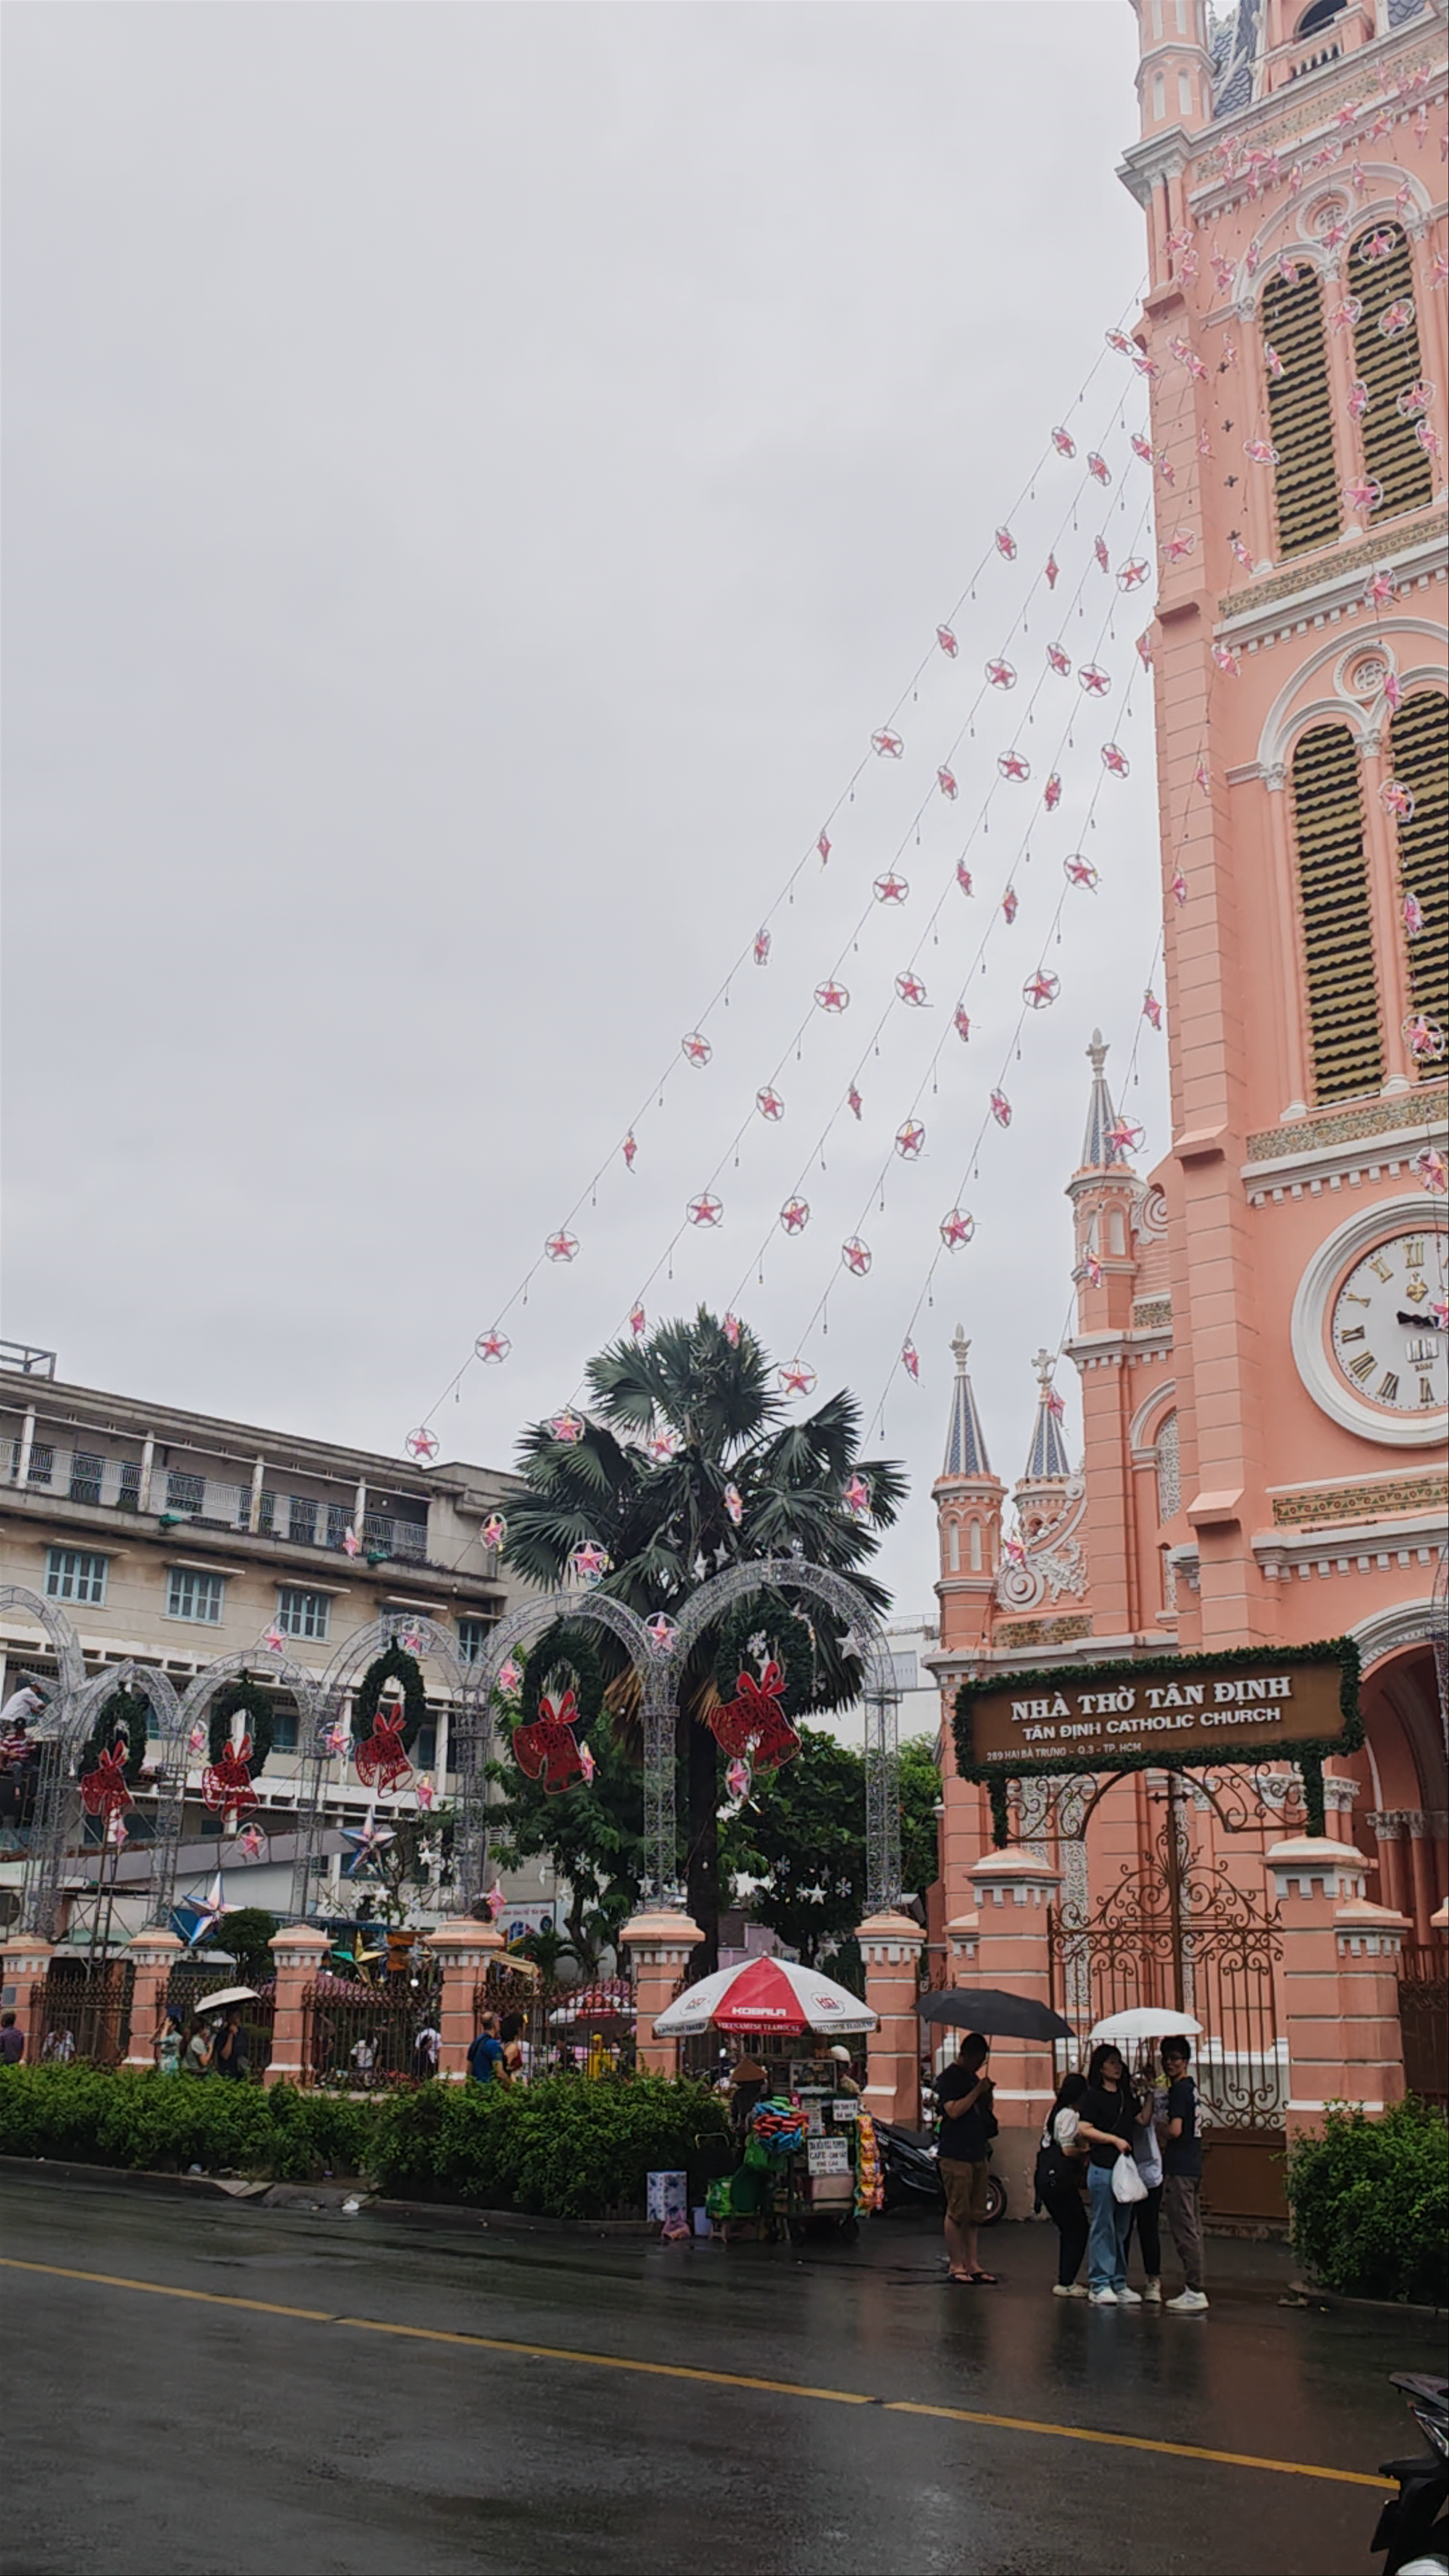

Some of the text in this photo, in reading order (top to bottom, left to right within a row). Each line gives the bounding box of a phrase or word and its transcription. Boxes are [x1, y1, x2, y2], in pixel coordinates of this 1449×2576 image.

[1403, 1242, 1424, 1268] XII
[1419, 1378, 1434, 1403] VI
[1011, 1676, 1292, 1721] NHÀ THỜ TÂN ĐỊNH
[1022, 1707, 1281, 1741] TÂN ĐỊNH CATHOLIC CHURCH
[986, 1751, 1003, 1761] 289
[1005, 1749, 1019, 1759] HAI
[1021, 1747, 1034, 1758] BÀ
[1035, 1746, 1067, 1758] TRƯNG
[1077, 1744, 1094, 1755] Q.3
[732, 2006, 786, 2016] KOBALA
